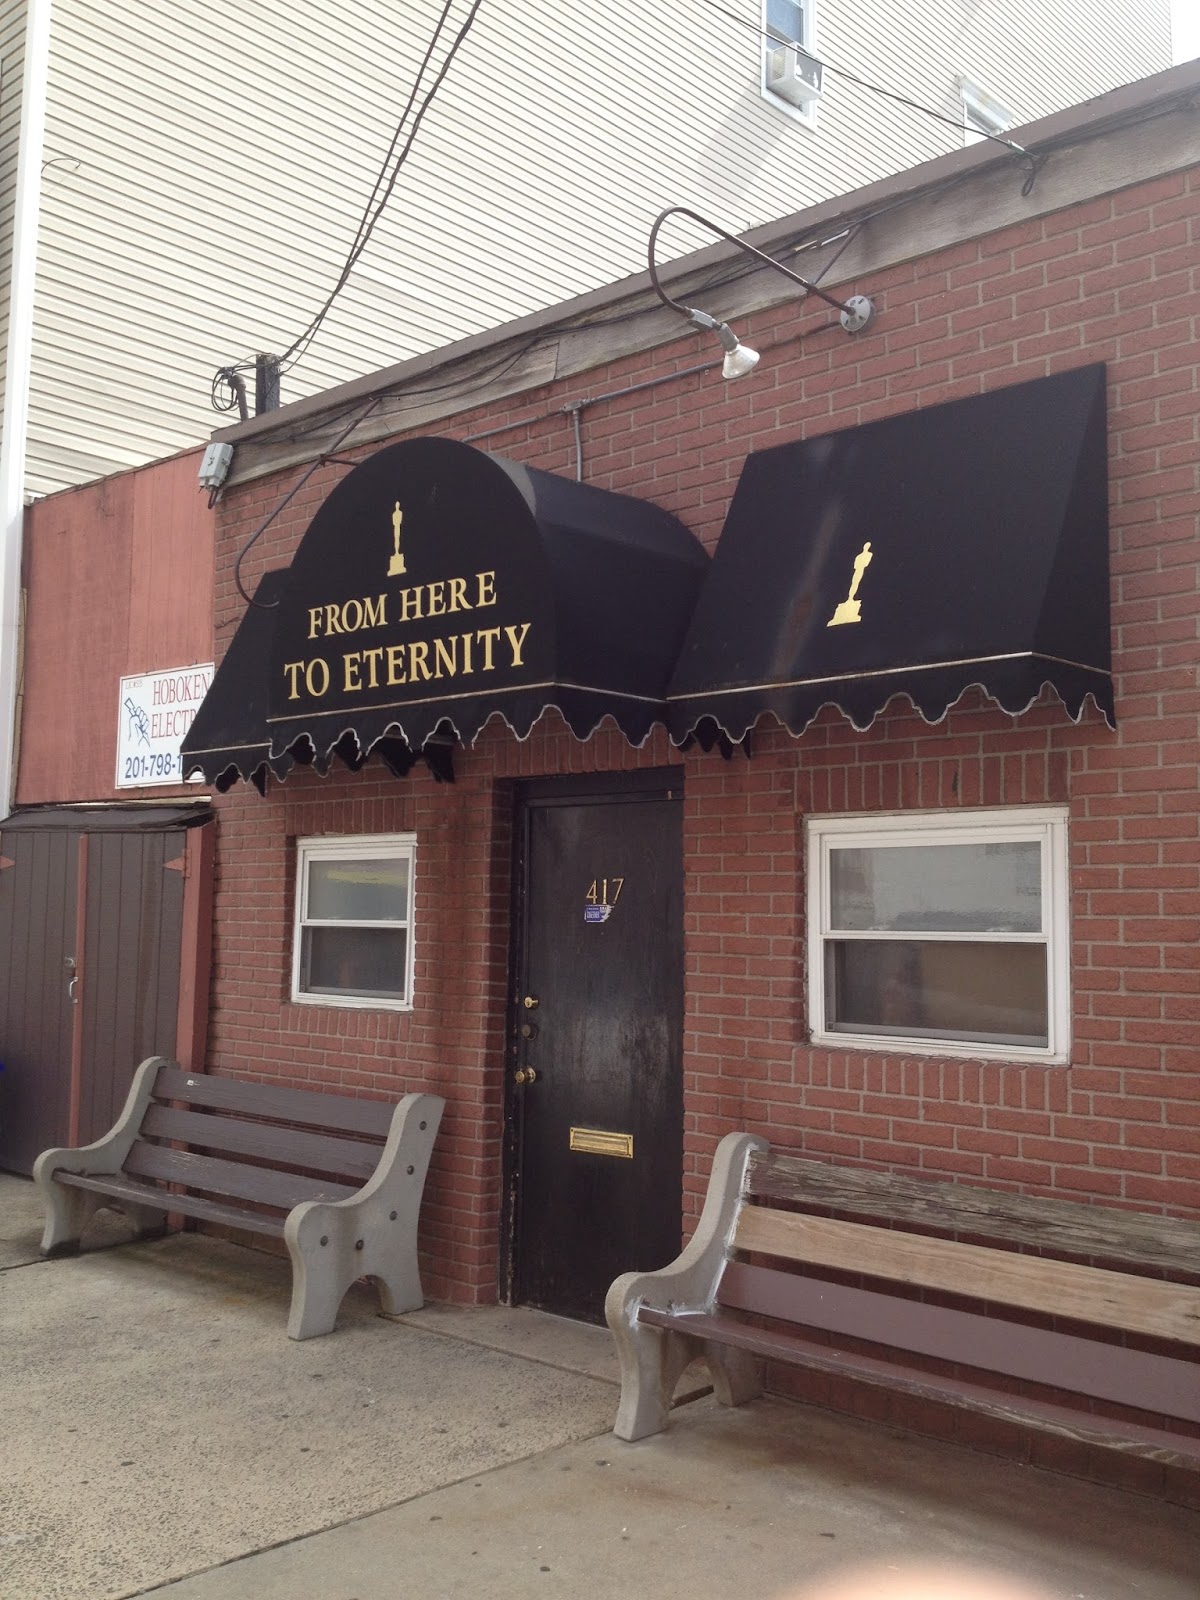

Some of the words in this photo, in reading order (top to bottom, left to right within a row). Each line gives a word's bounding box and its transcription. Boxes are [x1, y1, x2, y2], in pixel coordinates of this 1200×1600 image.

[307, 593, 388, 639] FROM
[399, 570, 497, 622] HERE
[284, 658, 330, 700] TO
[342, 623, 532, 692] ETERNITY
[152, 672, 210, 706] HOBOKEN
[586, 878, 624, 905] 417
